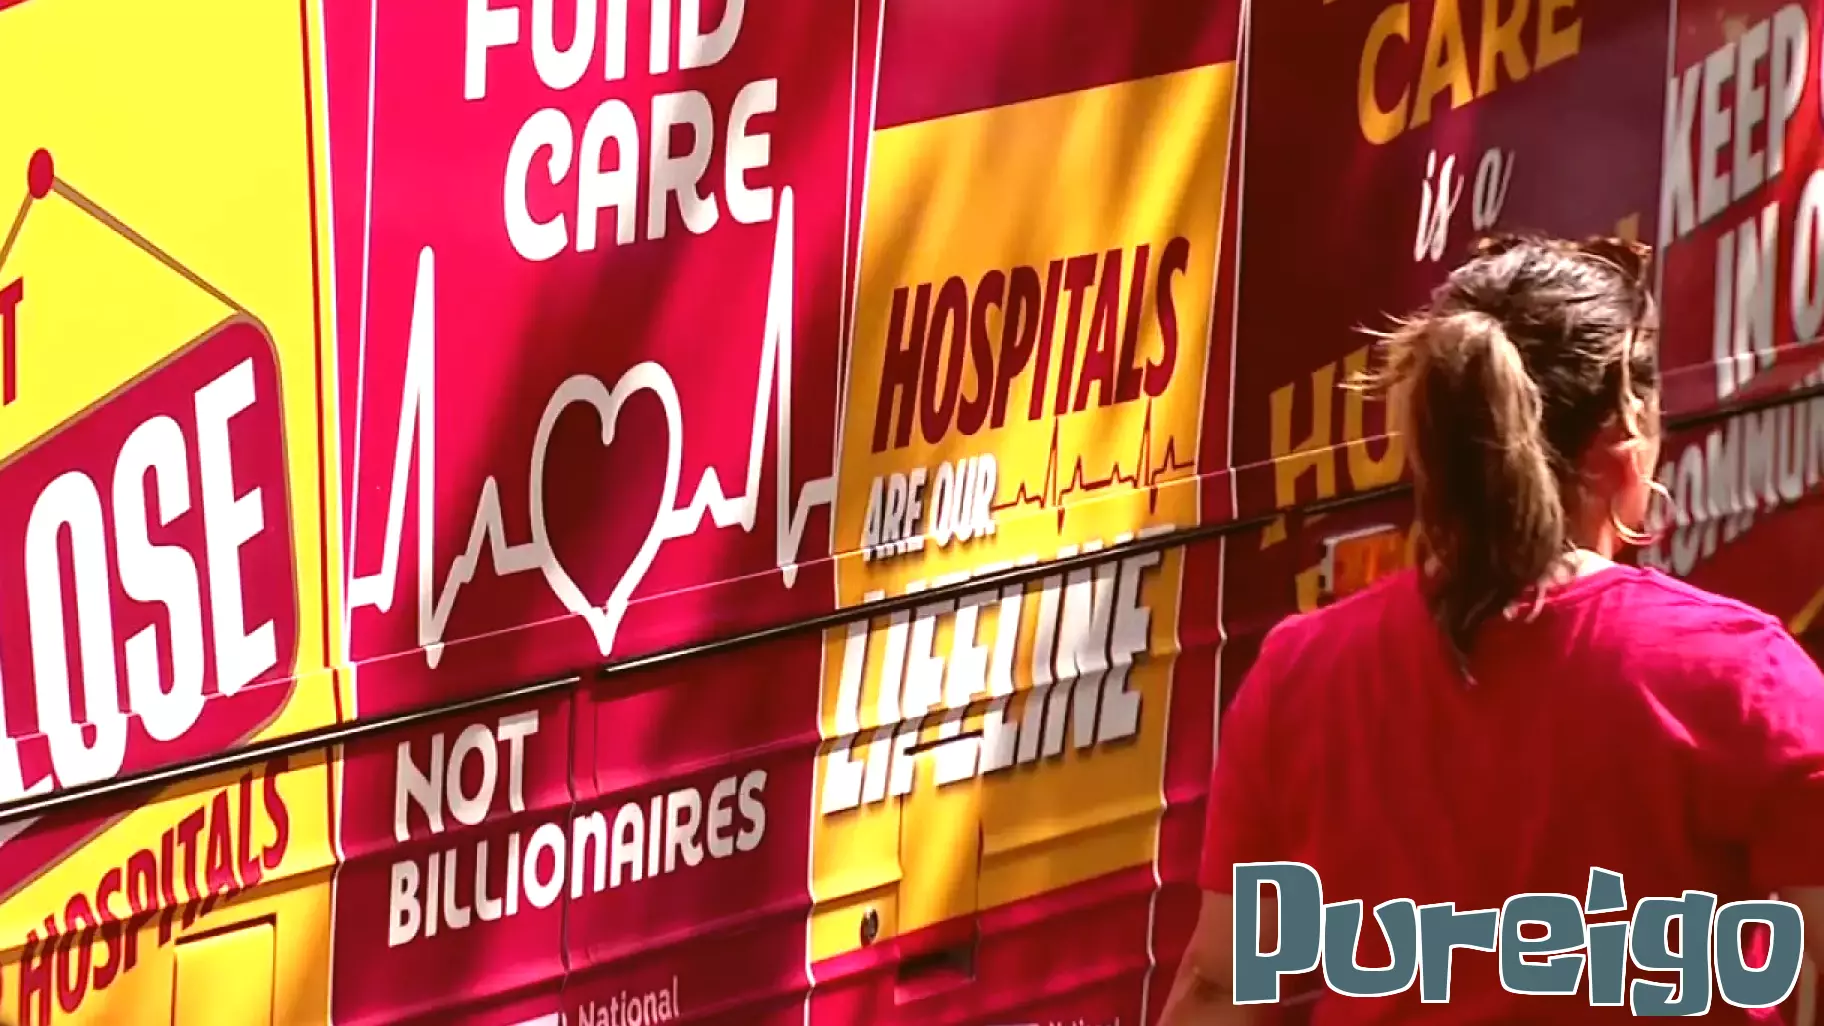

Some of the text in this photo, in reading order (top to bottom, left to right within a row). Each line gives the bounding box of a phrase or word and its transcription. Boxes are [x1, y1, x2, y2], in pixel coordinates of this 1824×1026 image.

[464, 0, 746, 101] FUND
[1357, 0, 1583, 146] CARE
[1659, 2, 1810, 251] KEEP
[503, 77, 778, 262] CARE
[1413, 146, 1516, 263] is a
[870, 235, 1191, 454] HOSPITALS
[1713, 200, 1780, 400] IN
[860, 452, 998, 562] ARE OUR
[820, 524, 1177, 817] LIFELINE
[387, 769, 768, 948] BILLIONAIRES
[393, 710, 540, 843] NOT
[18, 753, 290, 1026] HOSPITALS
